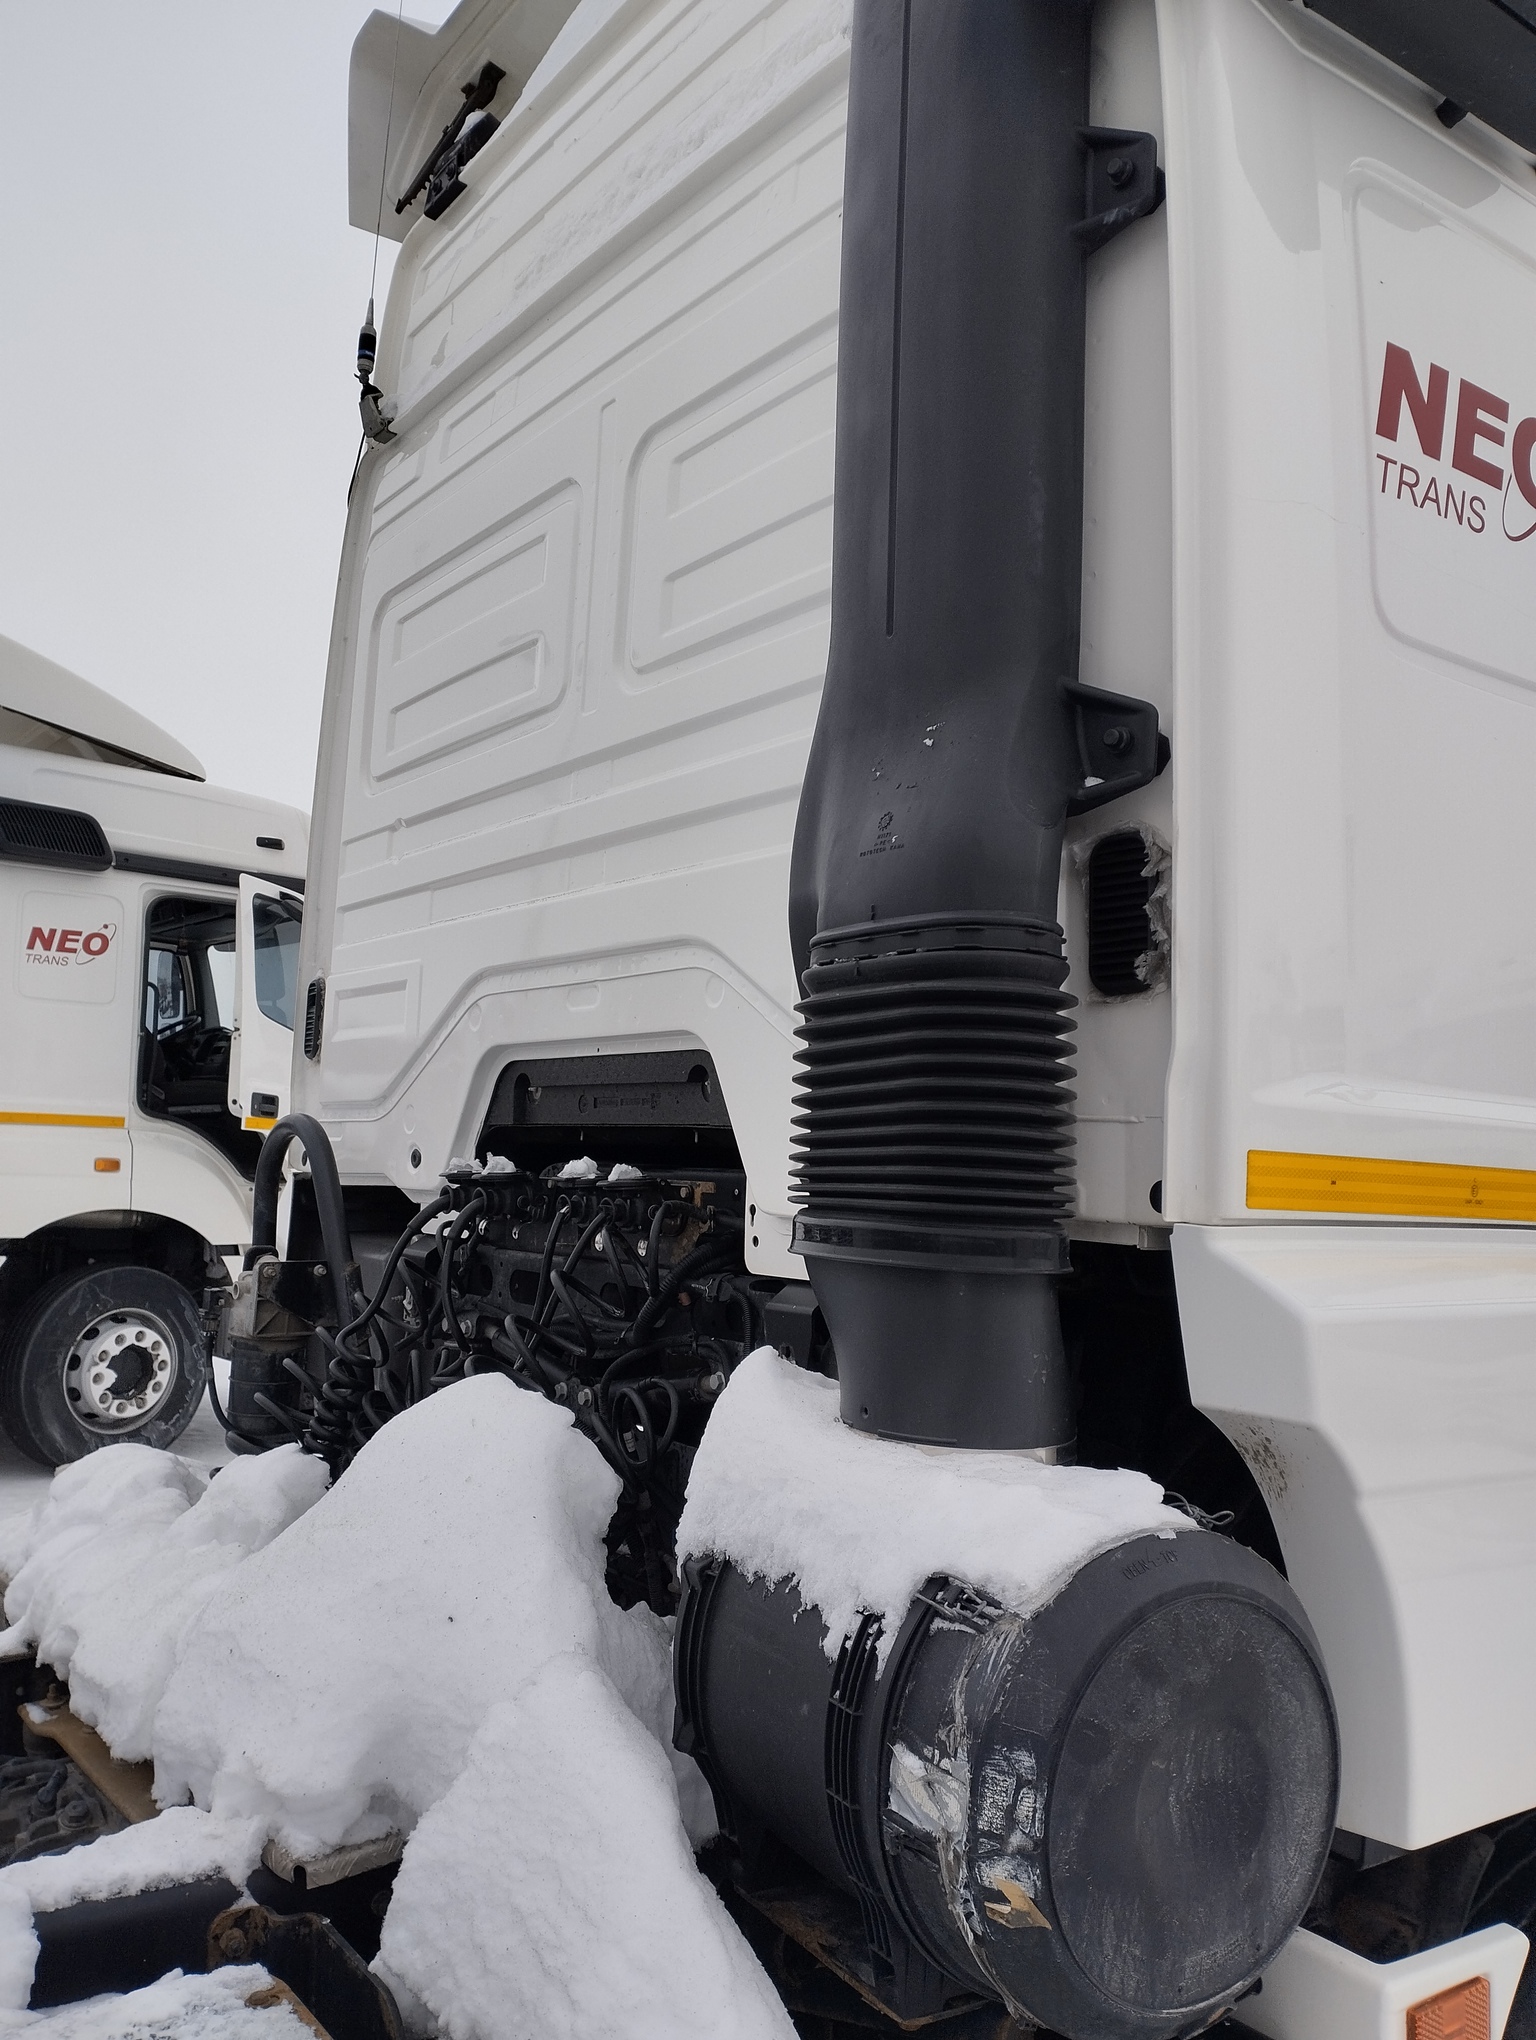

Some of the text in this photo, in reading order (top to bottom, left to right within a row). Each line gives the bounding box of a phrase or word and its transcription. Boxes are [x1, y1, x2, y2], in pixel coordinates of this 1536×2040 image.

[1376, 453, 1487, 534] TRANS
[26, 926, 110, 956] NEO
[25, 953, 70, 967] TRANS
